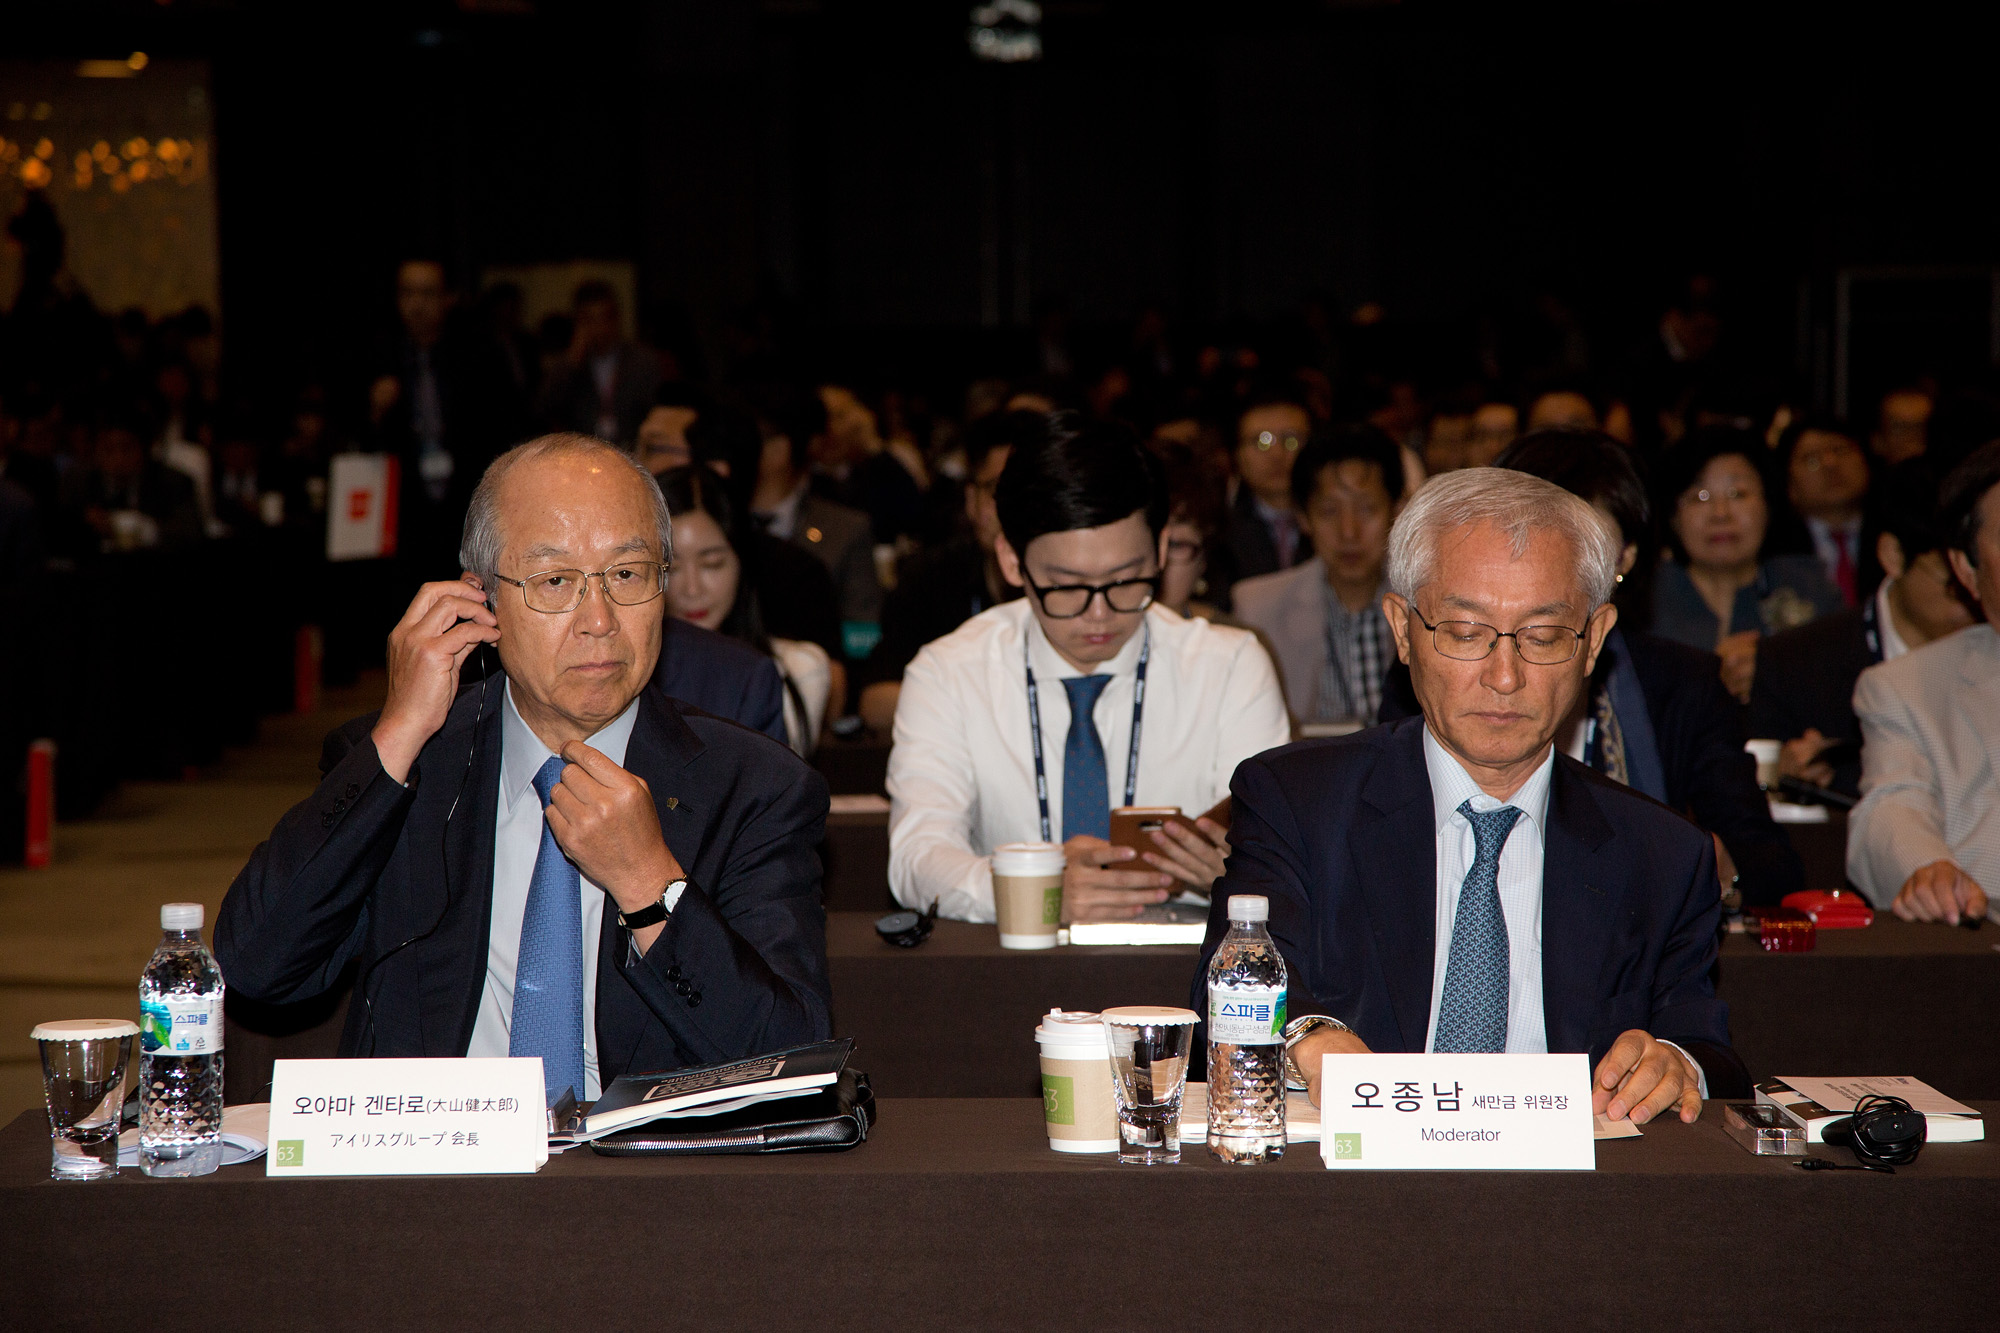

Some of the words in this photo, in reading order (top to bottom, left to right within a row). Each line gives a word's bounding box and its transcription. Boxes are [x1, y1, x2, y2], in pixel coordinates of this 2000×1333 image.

[174, 1013, 208, 1025] 스파클
[1221, 1003, 1271, 1021] 스파클
[293, 1095, 355, 1116] 오야마
[1043, 1087, 1059, 1112] 63
[1472, 1095, 1517, 1110] 새만금
[1524, 1095, 1569, 1110] 위원장
[330, 1131, 447, 1148] アイリスグループ
[452, 1131, 479, 1147] 会長
[1421, 1127, 1501, 1142] Moderator
[278, 1146, 295, 1161] 63
[1335, 1139, 1353, 1154] 63
